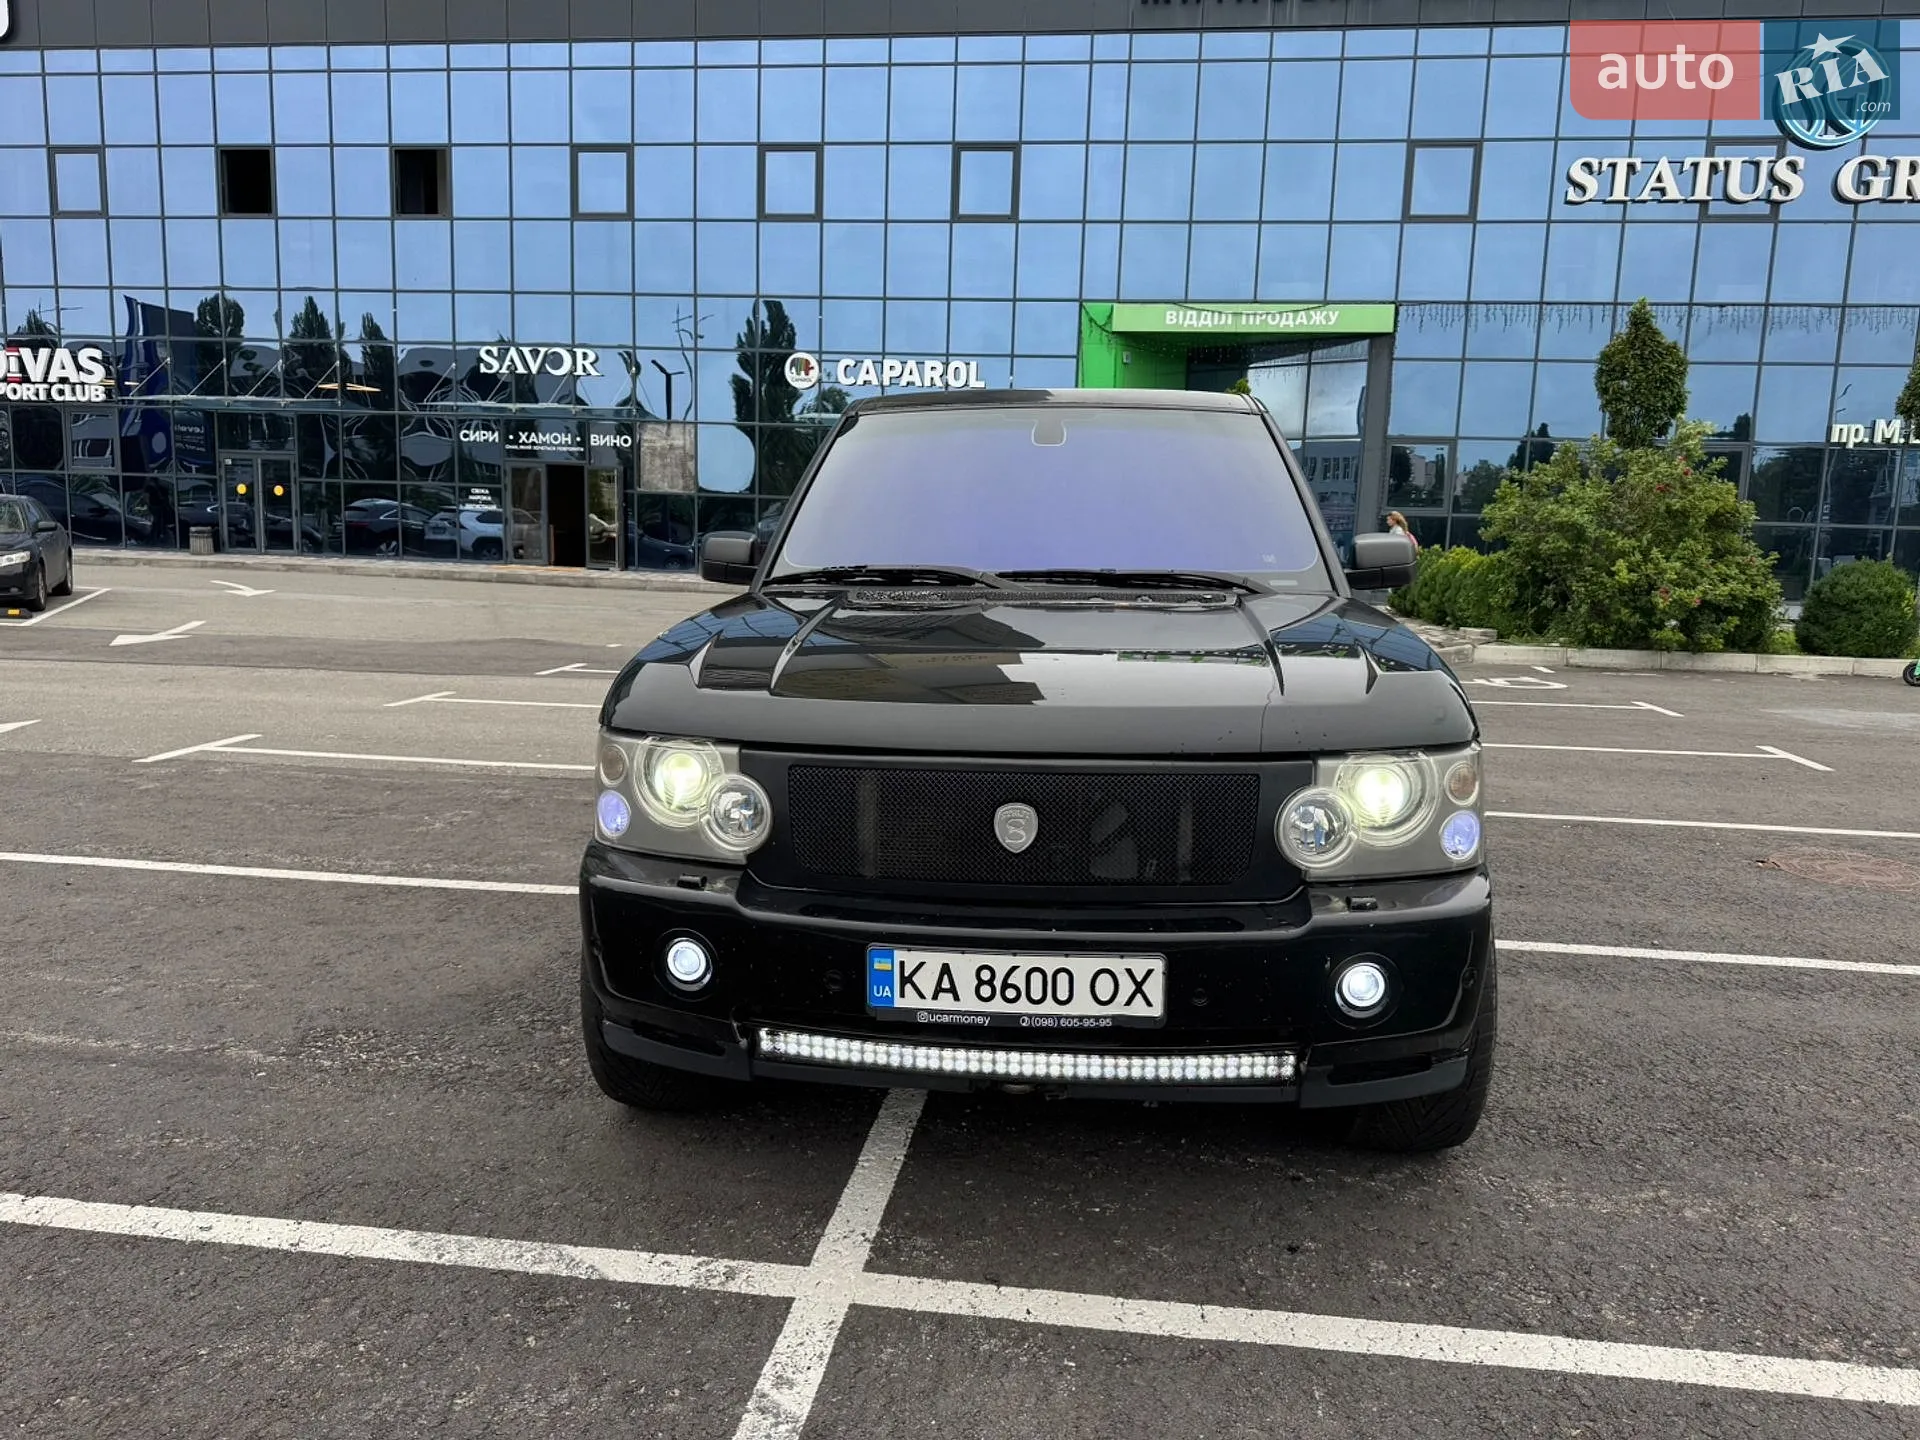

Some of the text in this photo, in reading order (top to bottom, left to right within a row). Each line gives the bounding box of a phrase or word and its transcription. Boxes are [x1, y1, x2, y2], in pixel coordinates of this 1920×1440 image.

[1567, 155, 1805, 203] STATUS
[1165, 310, 1340, 328] ВІДДІЛ ПРОДАЖУ
[0, 347, 107, 384] IVAS
[479, 345, 602, 376] SAVOR
[836, 358, 986, 388] CAPAROL
[50, 383, 107, 402] CLUB
[459, 429, 632, 447] СИРИ ХАМОН ВИНО
[1830, 423, 1870, 448] пр.
[873, 985, 892, 999] UA
[899, 960, 1155, 1008] KA 8600 OX
[1031, 1016, 1058, 1028] (098)
